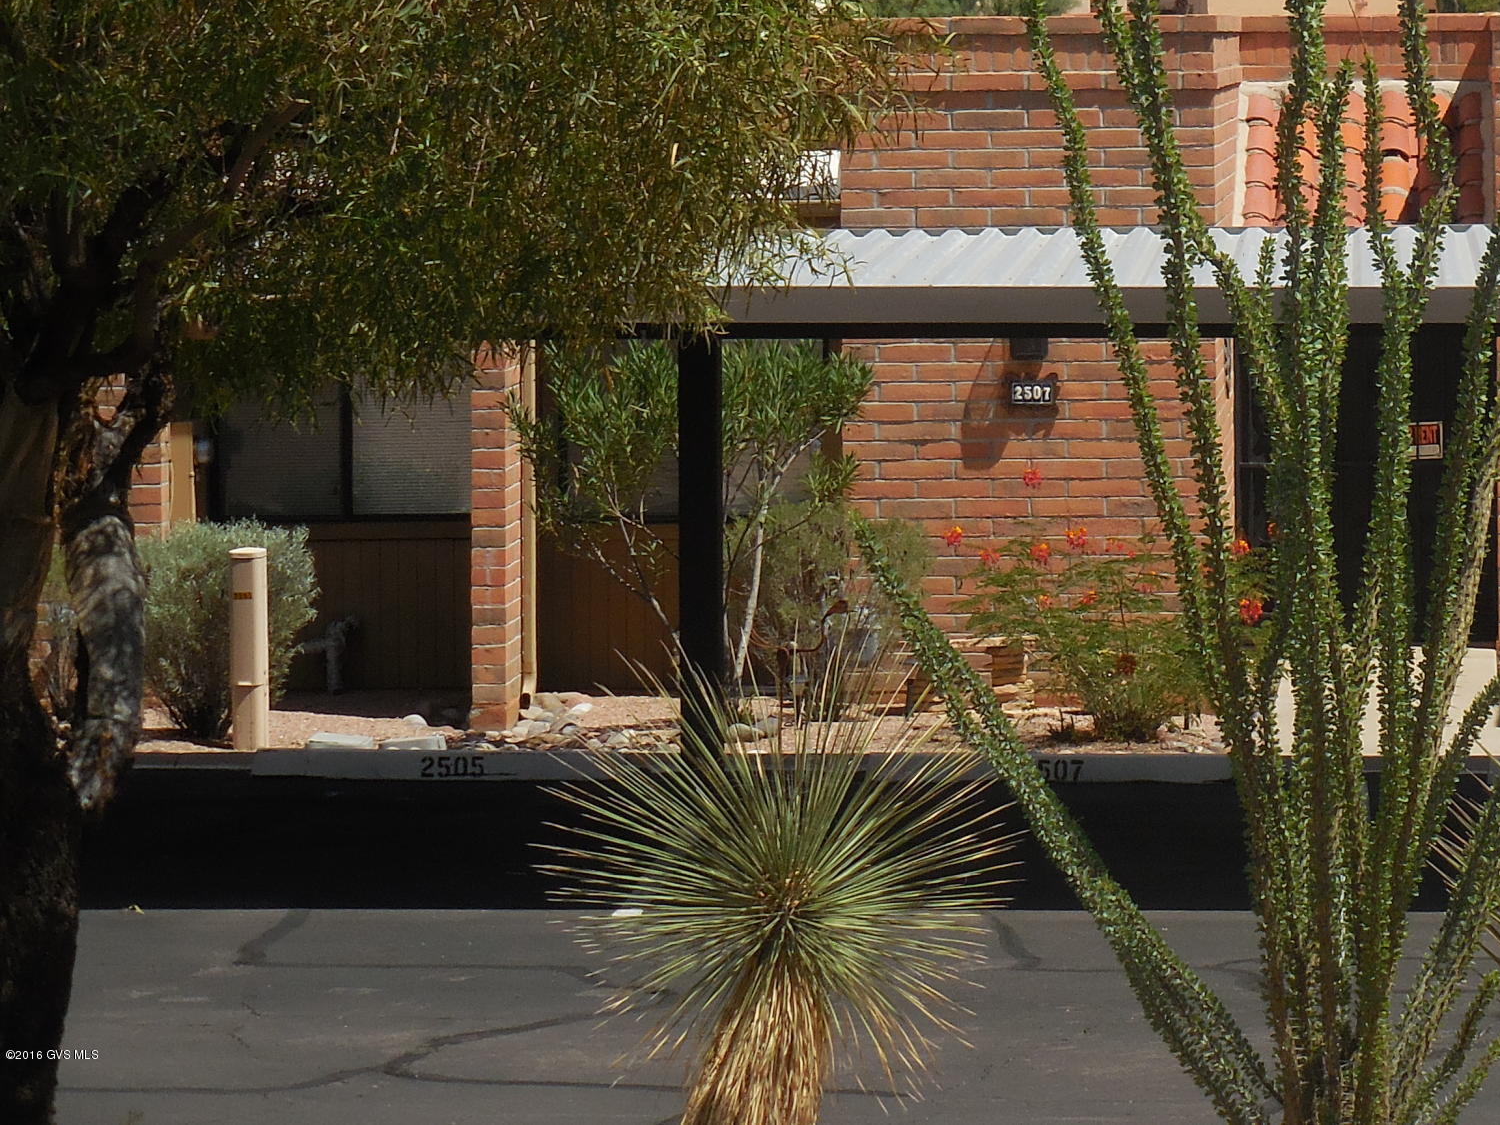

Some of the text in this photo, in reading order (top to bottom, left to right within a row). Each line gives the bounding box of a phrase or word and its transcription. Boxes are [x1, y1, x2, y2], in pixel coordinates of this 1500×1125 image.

[1014, 385, 1051, 401] 2507
[420, 756, 485, 778] 2505
[1038, 759, 1084, 781] 507
